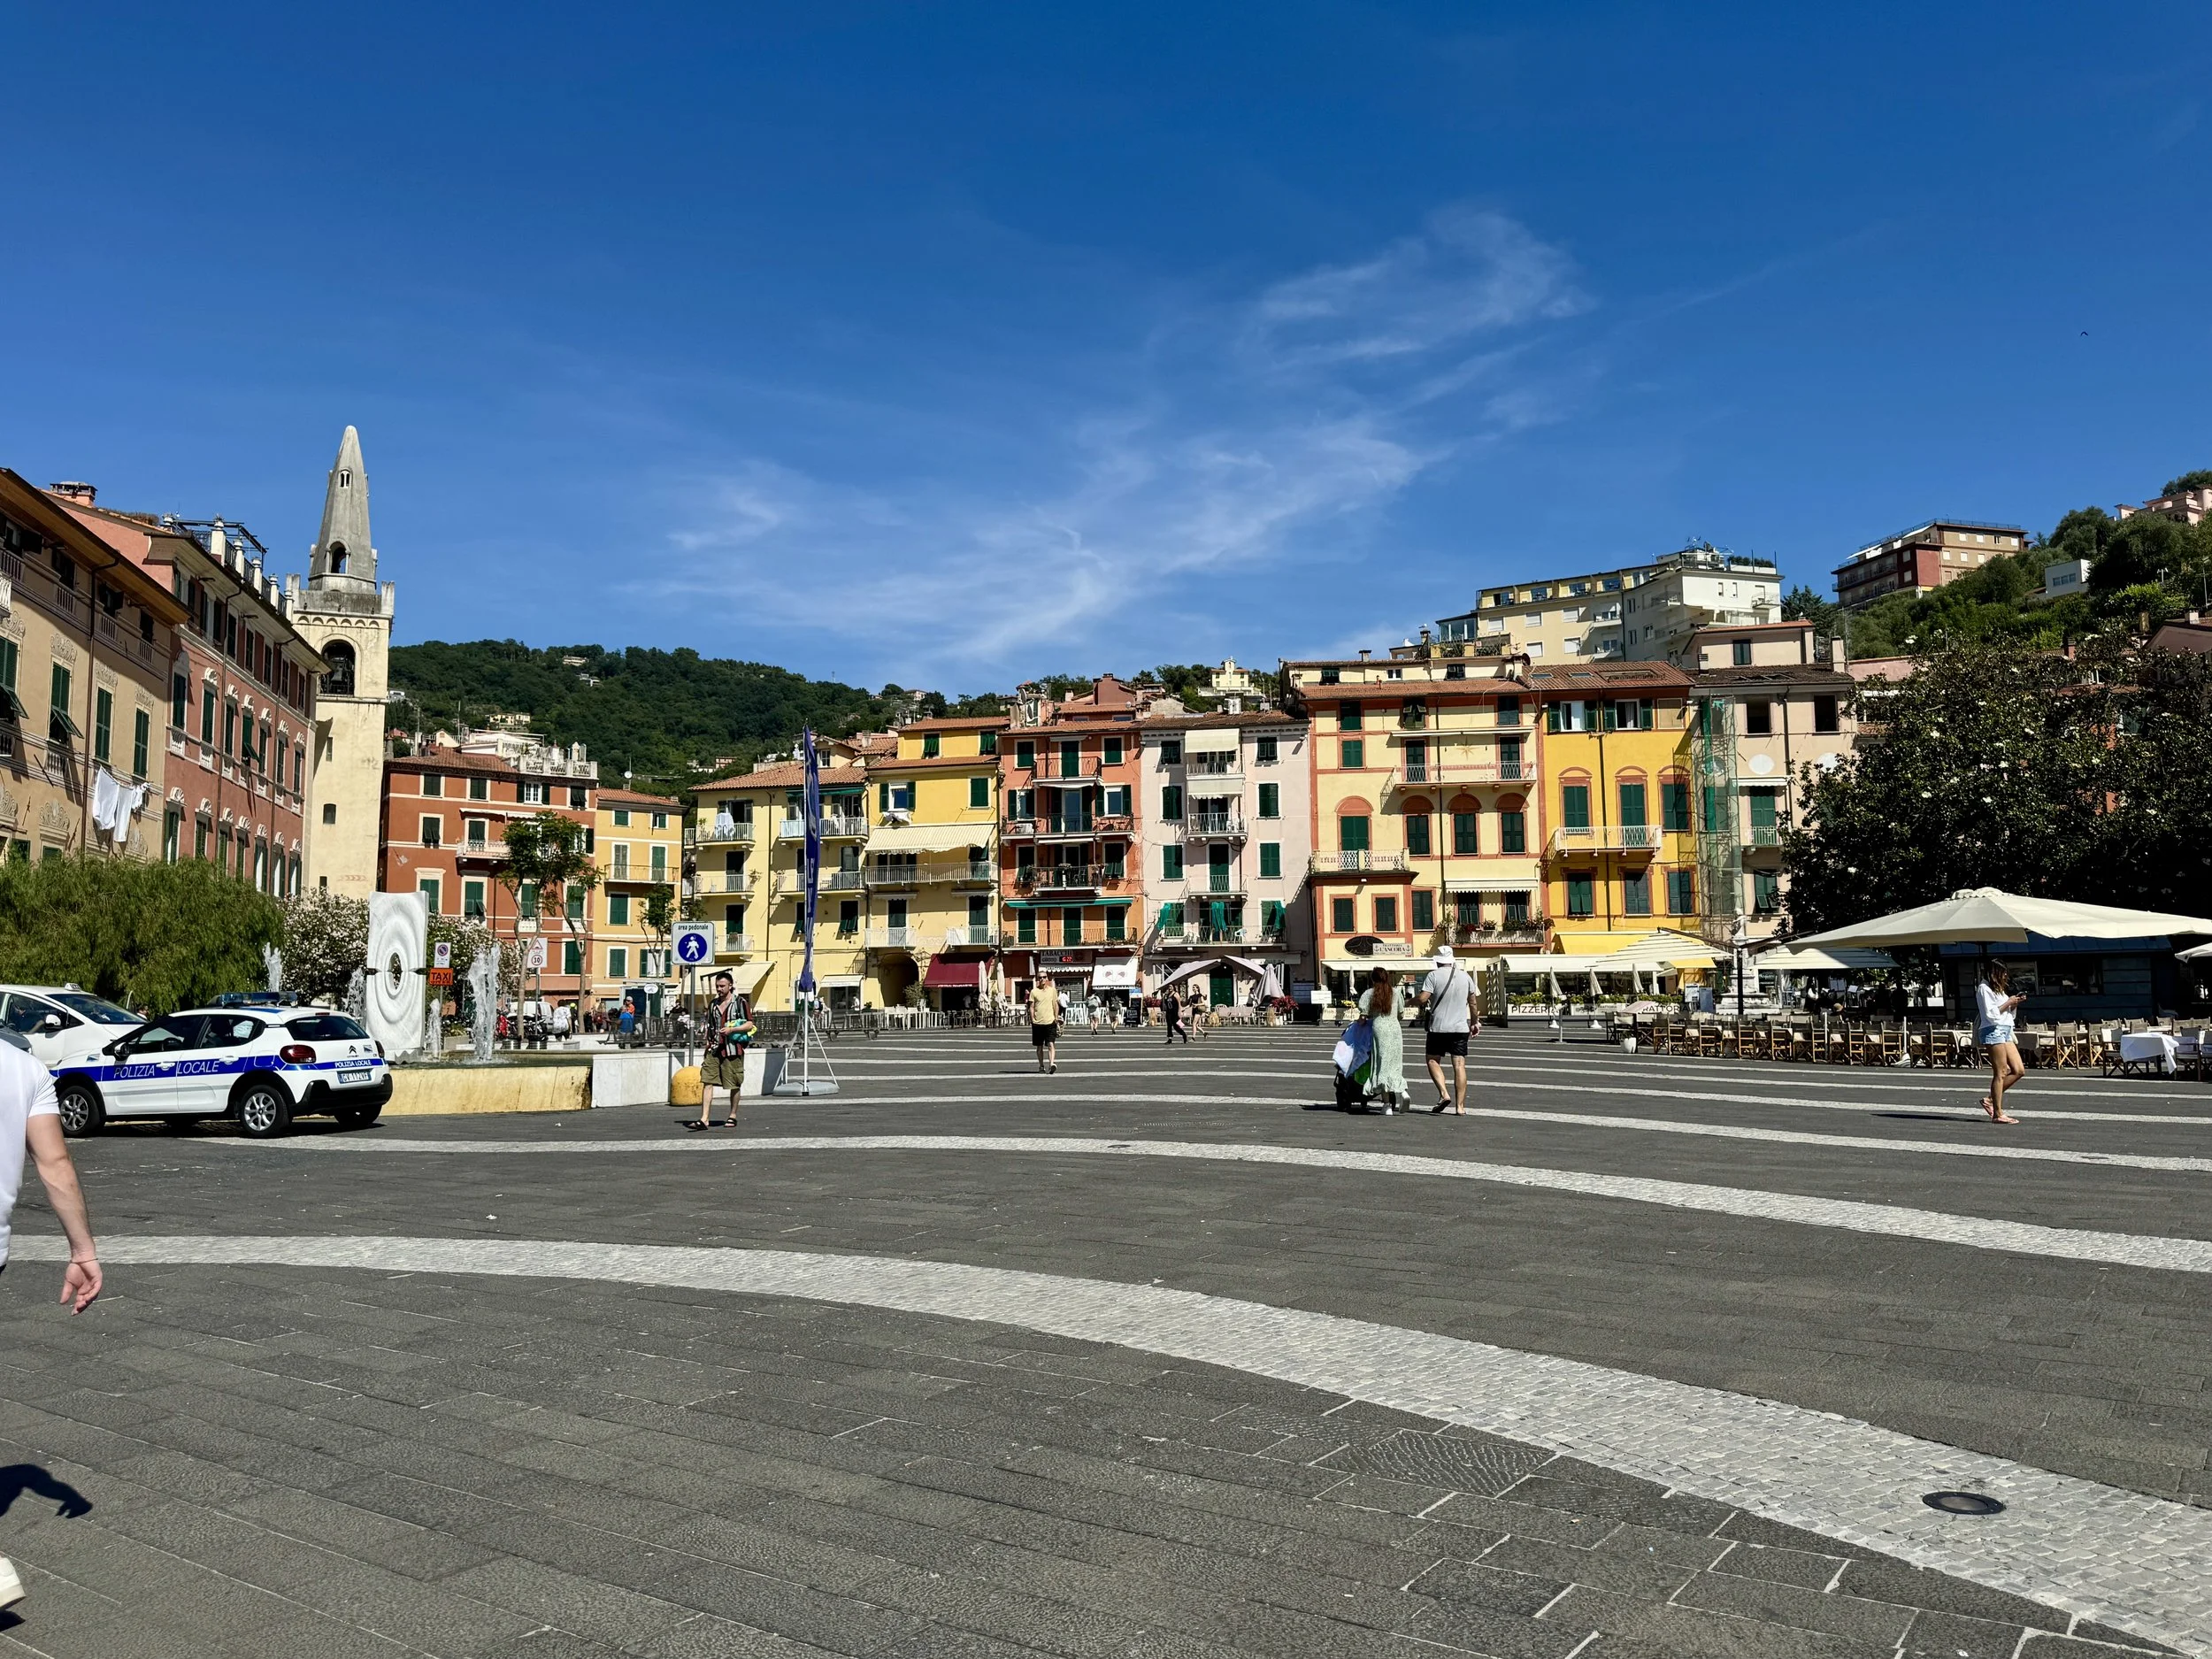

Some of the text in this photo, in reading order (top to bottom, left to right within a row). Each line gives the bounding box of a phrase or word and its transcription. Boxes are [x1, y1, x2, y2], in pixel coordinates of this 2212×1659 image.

[431, 972, 451, 982] TAXI
[113, 1061, 219, 1079] POLIZIA LOCALE
